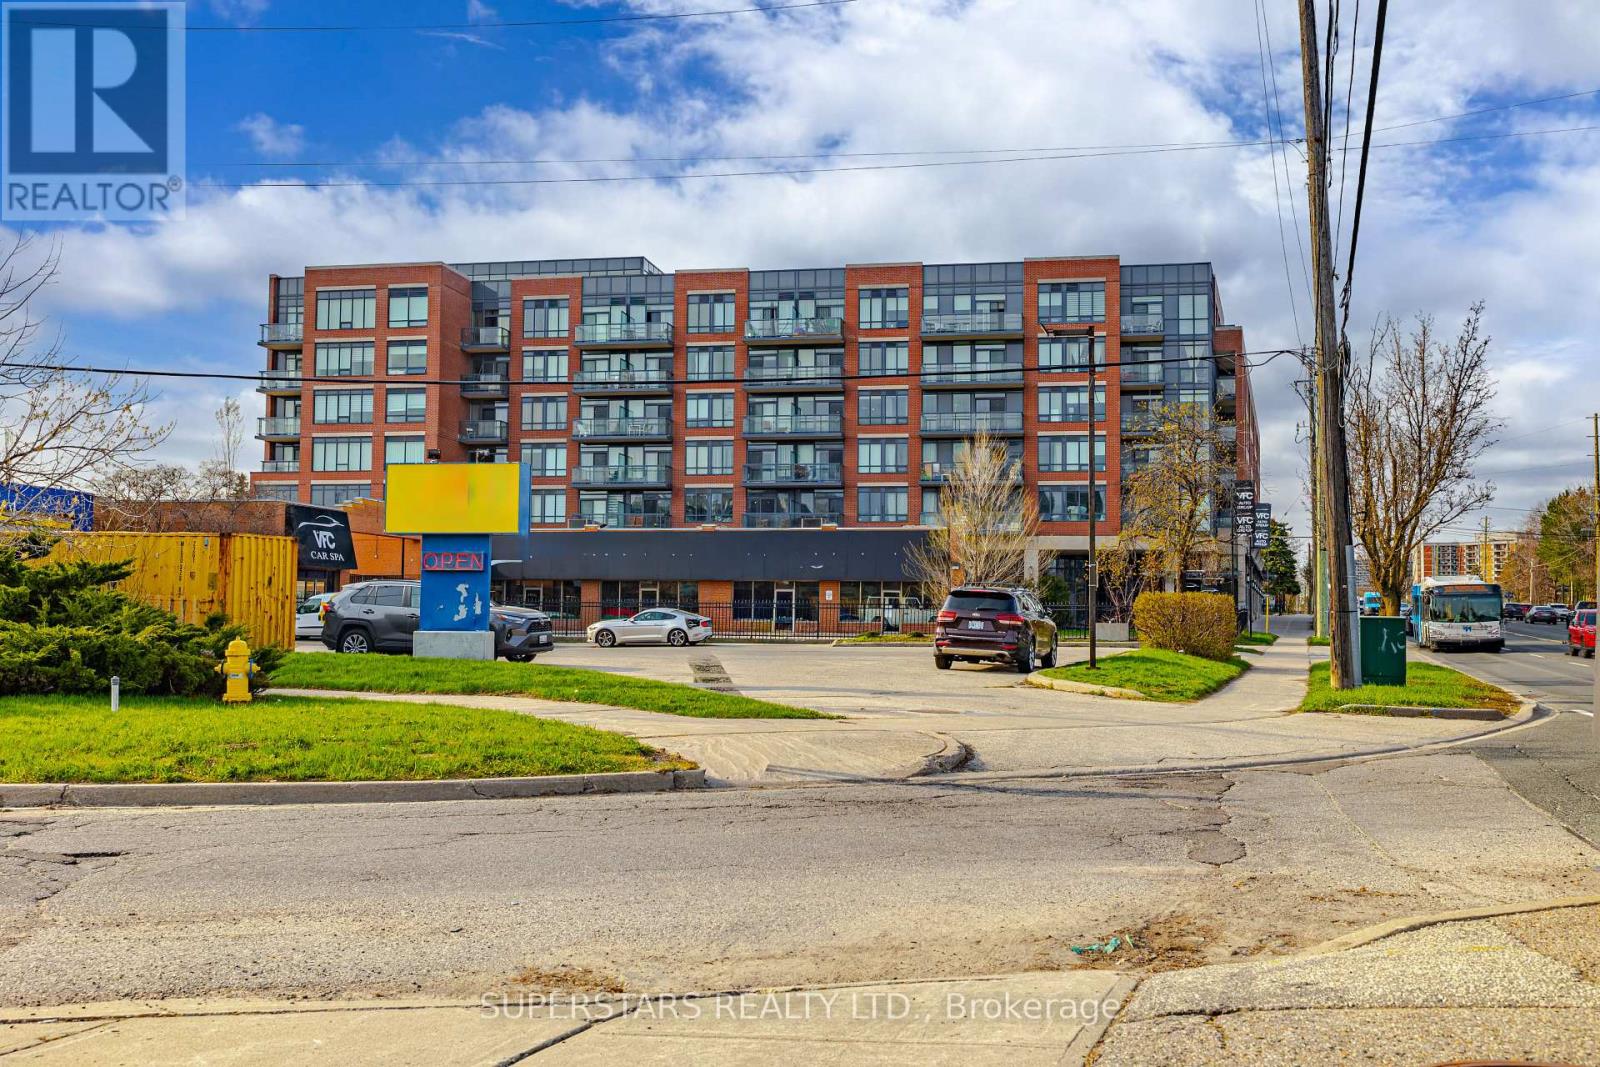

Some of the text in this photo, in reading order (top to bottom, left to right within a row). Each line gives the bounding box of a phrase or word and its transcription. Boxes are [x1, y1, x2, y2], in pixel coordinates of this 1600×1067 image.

[1236, 491, 1254, 500] VFC
[1236, 516, 1254, 524] VFC
[312, 529, 336, 549] VFC
[310, 550, 345, 562] CAR SPA
[423, 552, 483, 570] OPEN
